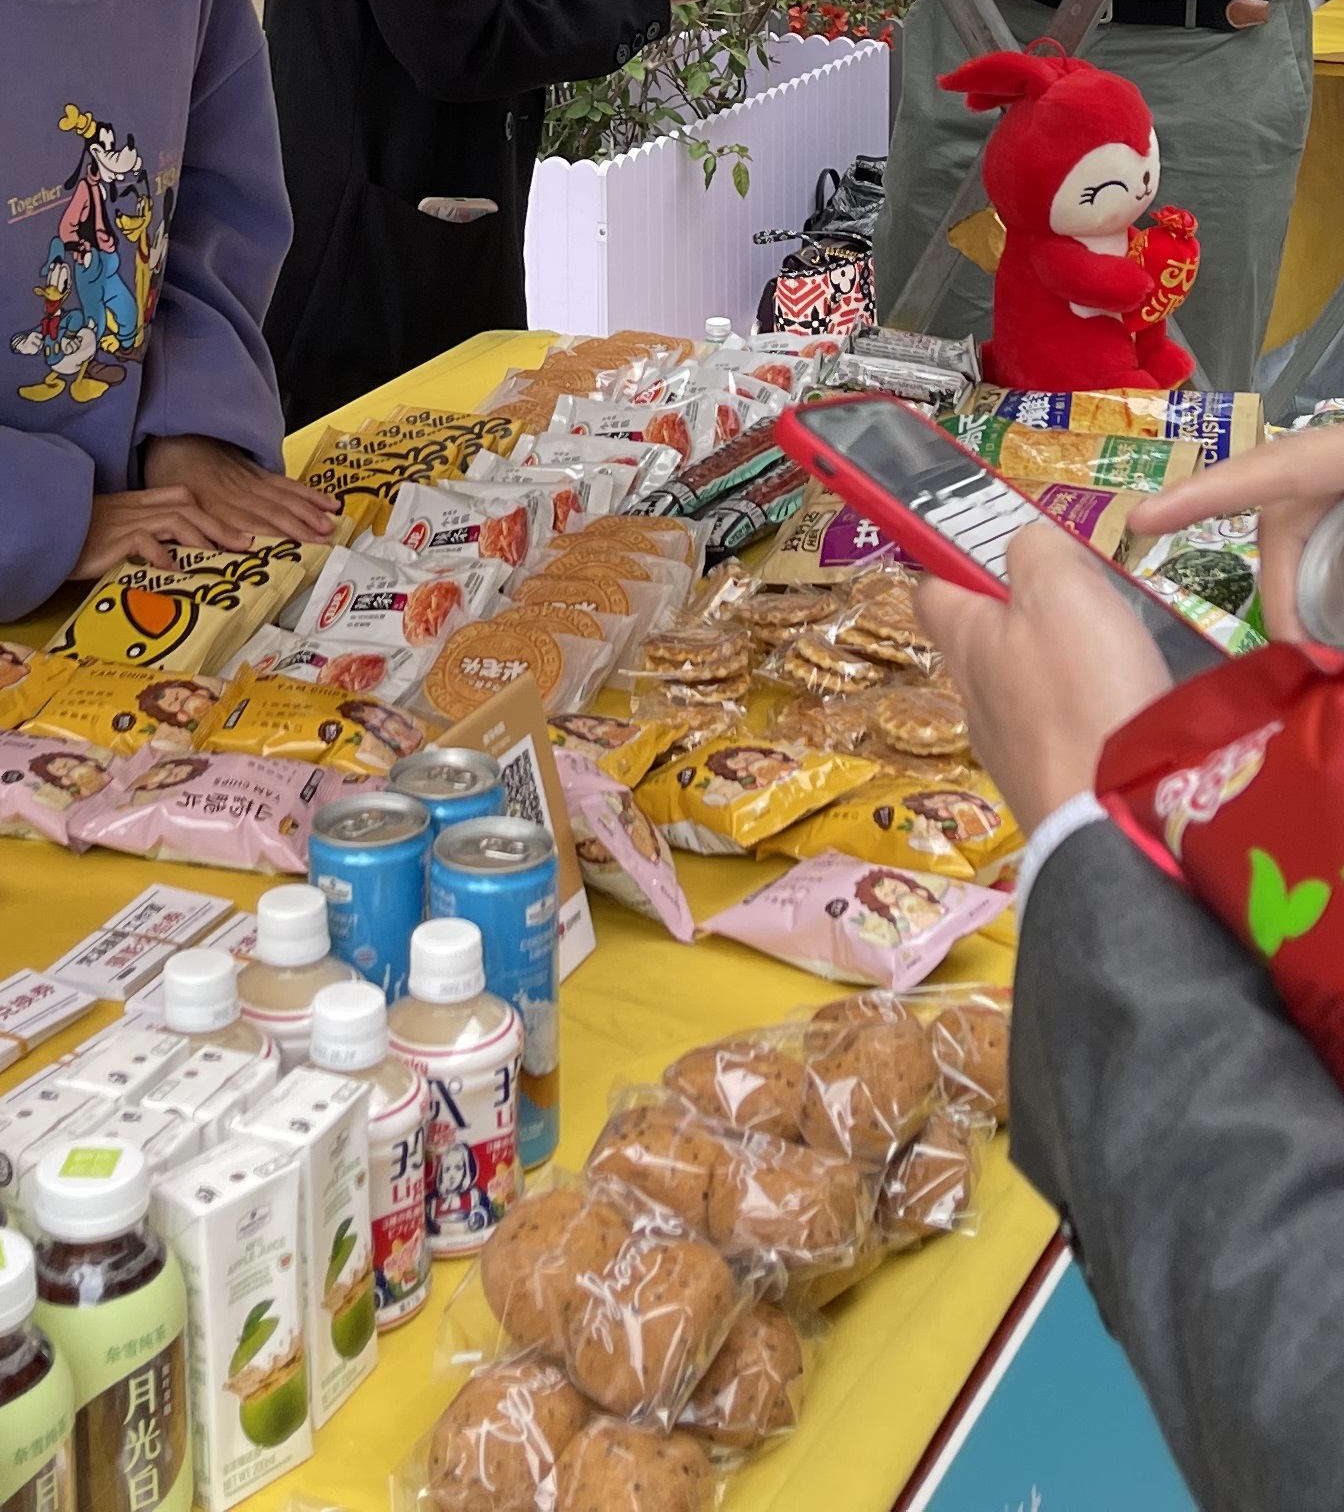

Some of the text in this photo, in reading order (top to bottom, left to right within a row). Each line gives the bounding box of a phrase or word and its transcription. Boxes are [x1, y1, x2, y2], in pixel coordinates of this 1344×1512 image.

[7, 183, 63, 216] Together
[406, 410, 432, 427] gg
[335, 435, 362, 451] gg
[308, 467, 336, 488] gg
[118, 568, 148, 585] gg
[119, 670, 156, 682] CHIPS
[123, 1368, 163, 1512] 月光白
